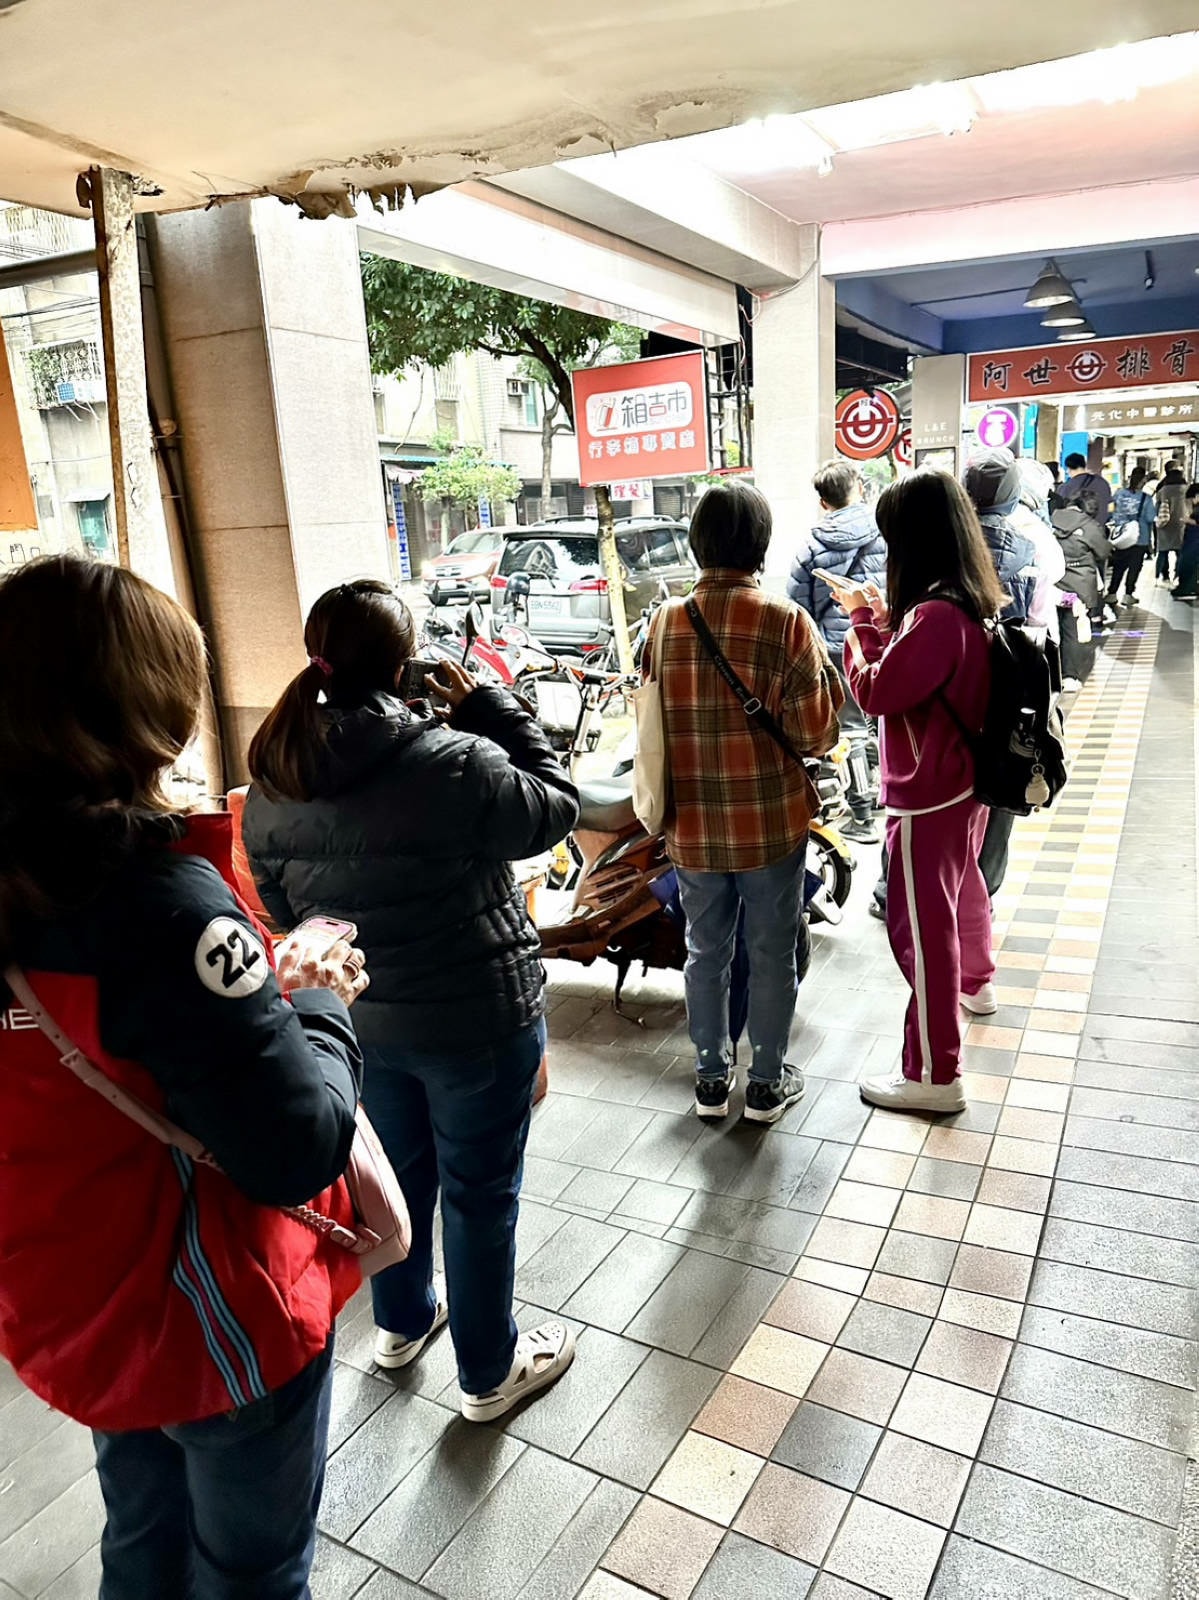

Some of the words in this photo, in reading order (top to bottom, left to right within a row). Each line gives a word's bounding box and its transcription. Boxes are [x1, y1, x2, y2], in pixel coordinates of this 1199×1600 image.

[588, 429, 695, 459] 行李箱專賣店
[206, 928, 261, 989] 22
